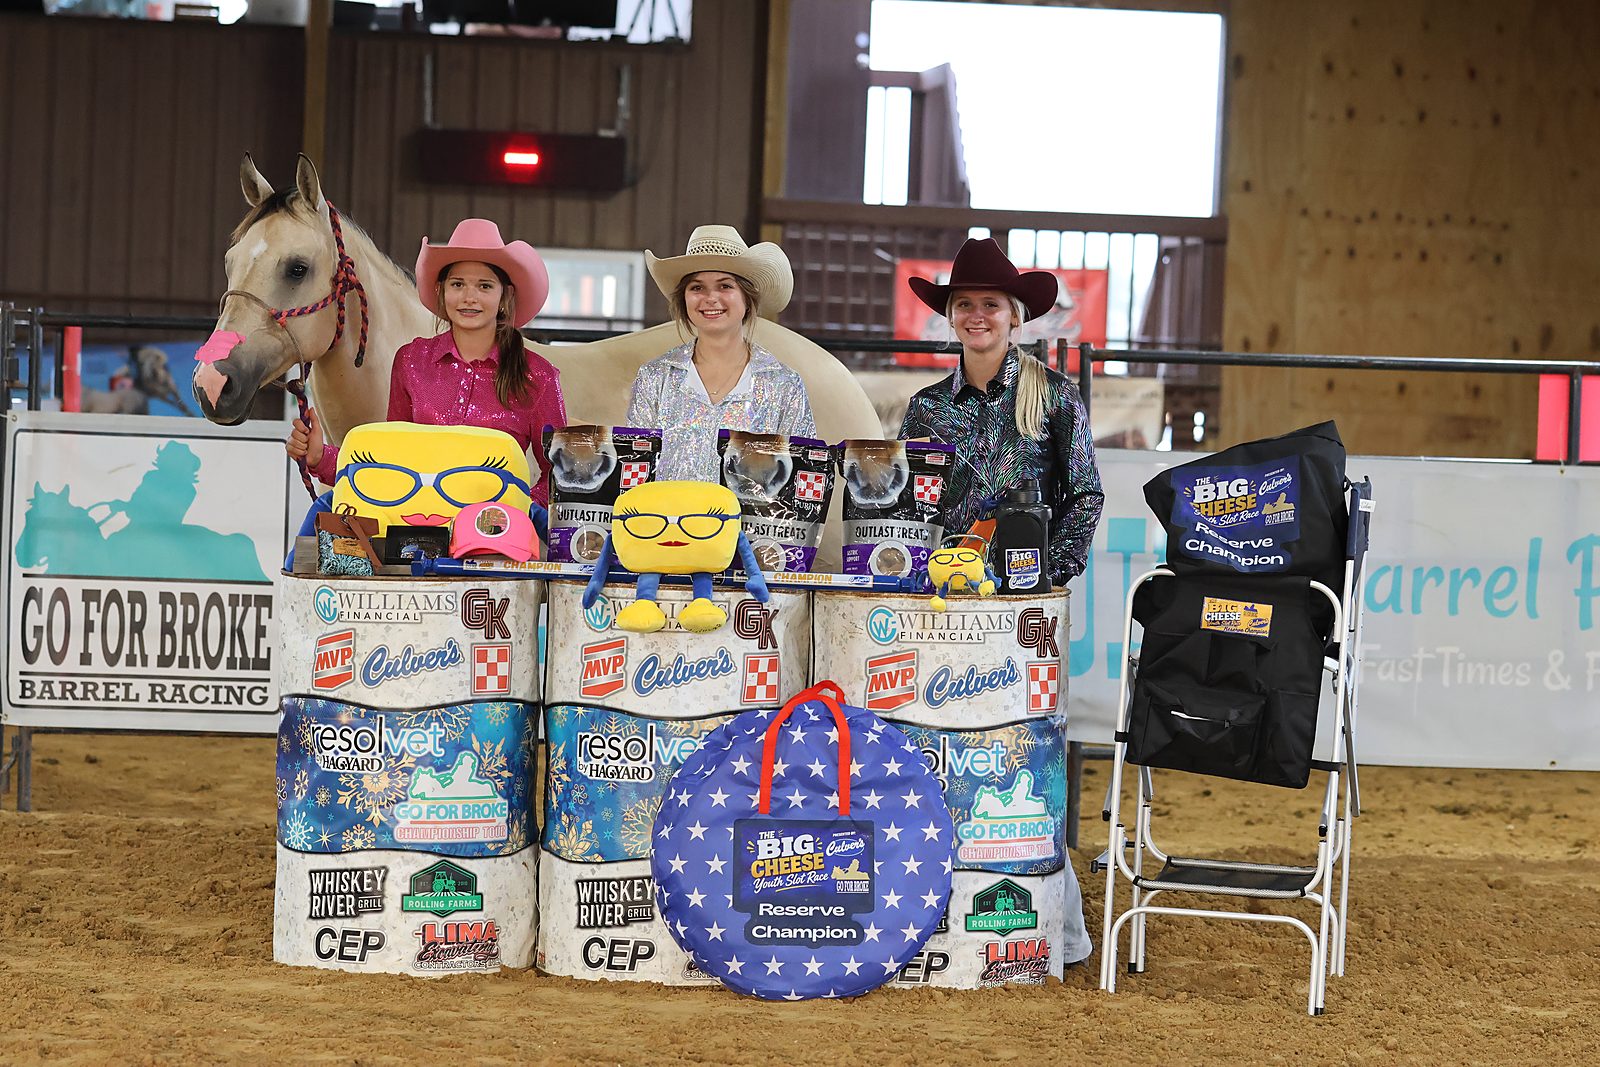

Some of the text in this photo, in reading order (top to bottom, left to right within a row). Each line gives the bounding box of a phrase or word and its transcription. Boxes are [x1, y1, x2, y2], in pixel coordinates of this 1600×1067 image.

[1193, 478, 1249, 503] BIG
[1195, 476, 1211, 486] THE
[1258, 472, 1293, 496] Culver's
[1218, 512, 1239, 526] Slot
[1239, 510, 1260, 521] Race
[740, 521, 807, 540] TLAST TREATS
[855, 525, 929, 541] OUTLAST TREATS
[1195, 521, 1274, 550] Reserve
[1009, 558, 1036, 569] CHEESE
[1011, 551, 1032, 562] BIG
[1185, 539, 1284, 566] Champion
[503, 560, 562, 572] CHAMPION
[773, 572, 833, 584] CHAMPION
[1363, 536, 1543, 620] arrel
[339, 592, 456, 611] WILLIAMS
[1207, 602, 1239, 613] BIG
[340, 611, 420, 622] FINANCIAL
[461, 588, 512, 640] GK
[734, 600, 779, 650] GK
[898, 612, 1014, 632] WILLIAMS
[1204, 612, 1242, 621] CHEESE
[21, 585, 273, 671] GO FOR BROKE
[900, 632, 983, 641] FINANCIAL
[1017, 608, 1060, 658] GK
[315, 646, 353, 672] MVP
[362, 640, 461, 687] Culver's
[583, 654, 624, 679] MVP
[1436, 645, 1531, 688] Times
[1543, 649, 1572, 691] &
[633, 648, 734, 695] Culver's
[868, 667, 916, 693] MVP
[925, 657, 1021, 706] Culver's
[19, 679, 269, 706] BARREL RACING
[312, 716, 446, 756] resolvet
[578, 725, 700, 764] resolve
[322, 754, 384, 772] HAGYARD
[922, 737, 1006, 776] olvet
[578, 761, 653, 781] by HAGYARD
[394, 801, 507, 820] GO FOR BROKE
[396, 827, 480, 840] CHAMPIONSHIP
[759, 831, 776, 839] THE
[959, 820, 1054, 839] GO FOR BROKE
[756, 834, 814, 860] BIG
[825, 837, 866, 857] Culver's
[961, 845, 1034, 859] CHAMPIONSHIP
[751, 852, 825, 879] CHEESE
[311, 870, 386, 895] WHISKEY
[578, 879, 655, 903] WHISKEY
[753, 870, 829, 894] Youth Slot Race
[311, 894, 383, 919] RIVER GRILL
[408, 899, 478, 909] ROLLING FARMS
[579, 904, 652, 927] RIVER GRILL
[759, 903, 845, 916] Reserve
[422, 922, 497, 945] LIMA
[751, 925, 857, 942] Champion
[972, 918, 1032, 928] ROLLING FARMS
[315, 927, 386, 962] CEP
[582, 937, 656, 971] CEP
[986, 939, 1049, 965] LIMA
[899, 952, 950, 983] EP
